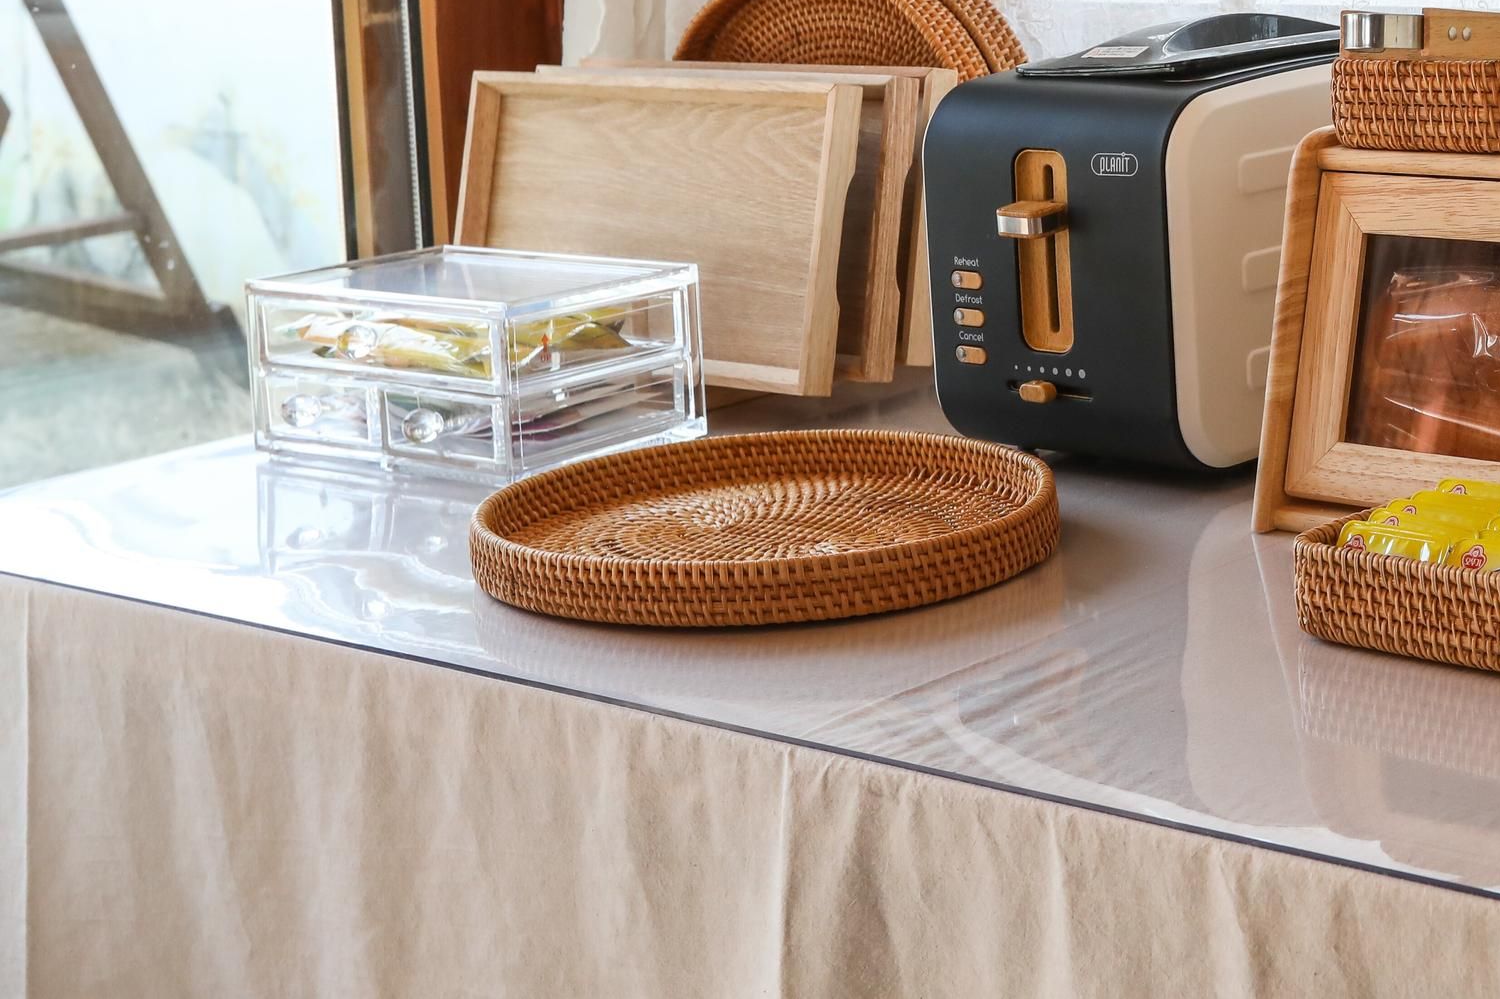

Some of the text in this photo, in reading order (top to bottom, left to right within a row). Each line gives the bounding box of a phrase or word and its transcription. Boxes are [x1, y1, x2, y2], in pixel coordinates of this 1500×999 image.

[953, 256, 979, 267] Reheat
[955, 293, 983, 305] Defrost
[959, 331, 985, 342] Cancel
